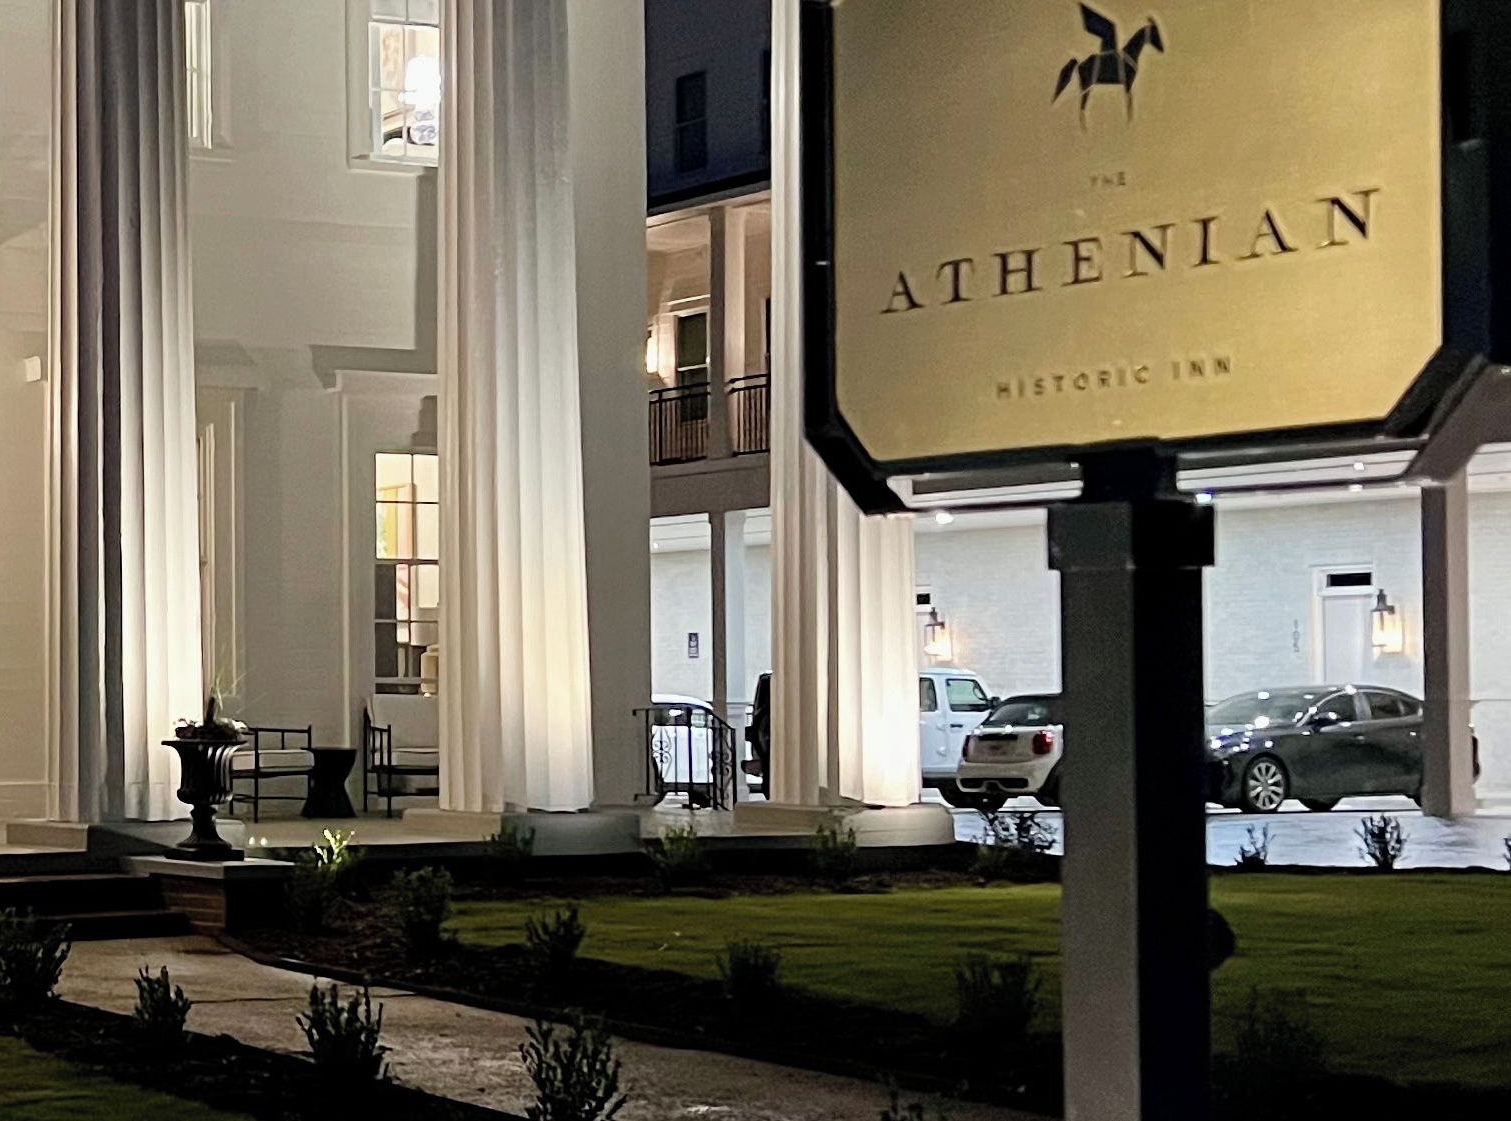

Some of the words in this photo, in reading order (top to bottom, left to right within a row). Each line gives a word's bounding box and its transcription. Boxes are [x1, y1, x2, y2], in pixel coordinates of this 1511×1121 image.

[878, 188, 1380, 314] ATHENIAN
[996, 364, 1150, 399] HISTORIC
[1172, 356, 1231, 381] INN
